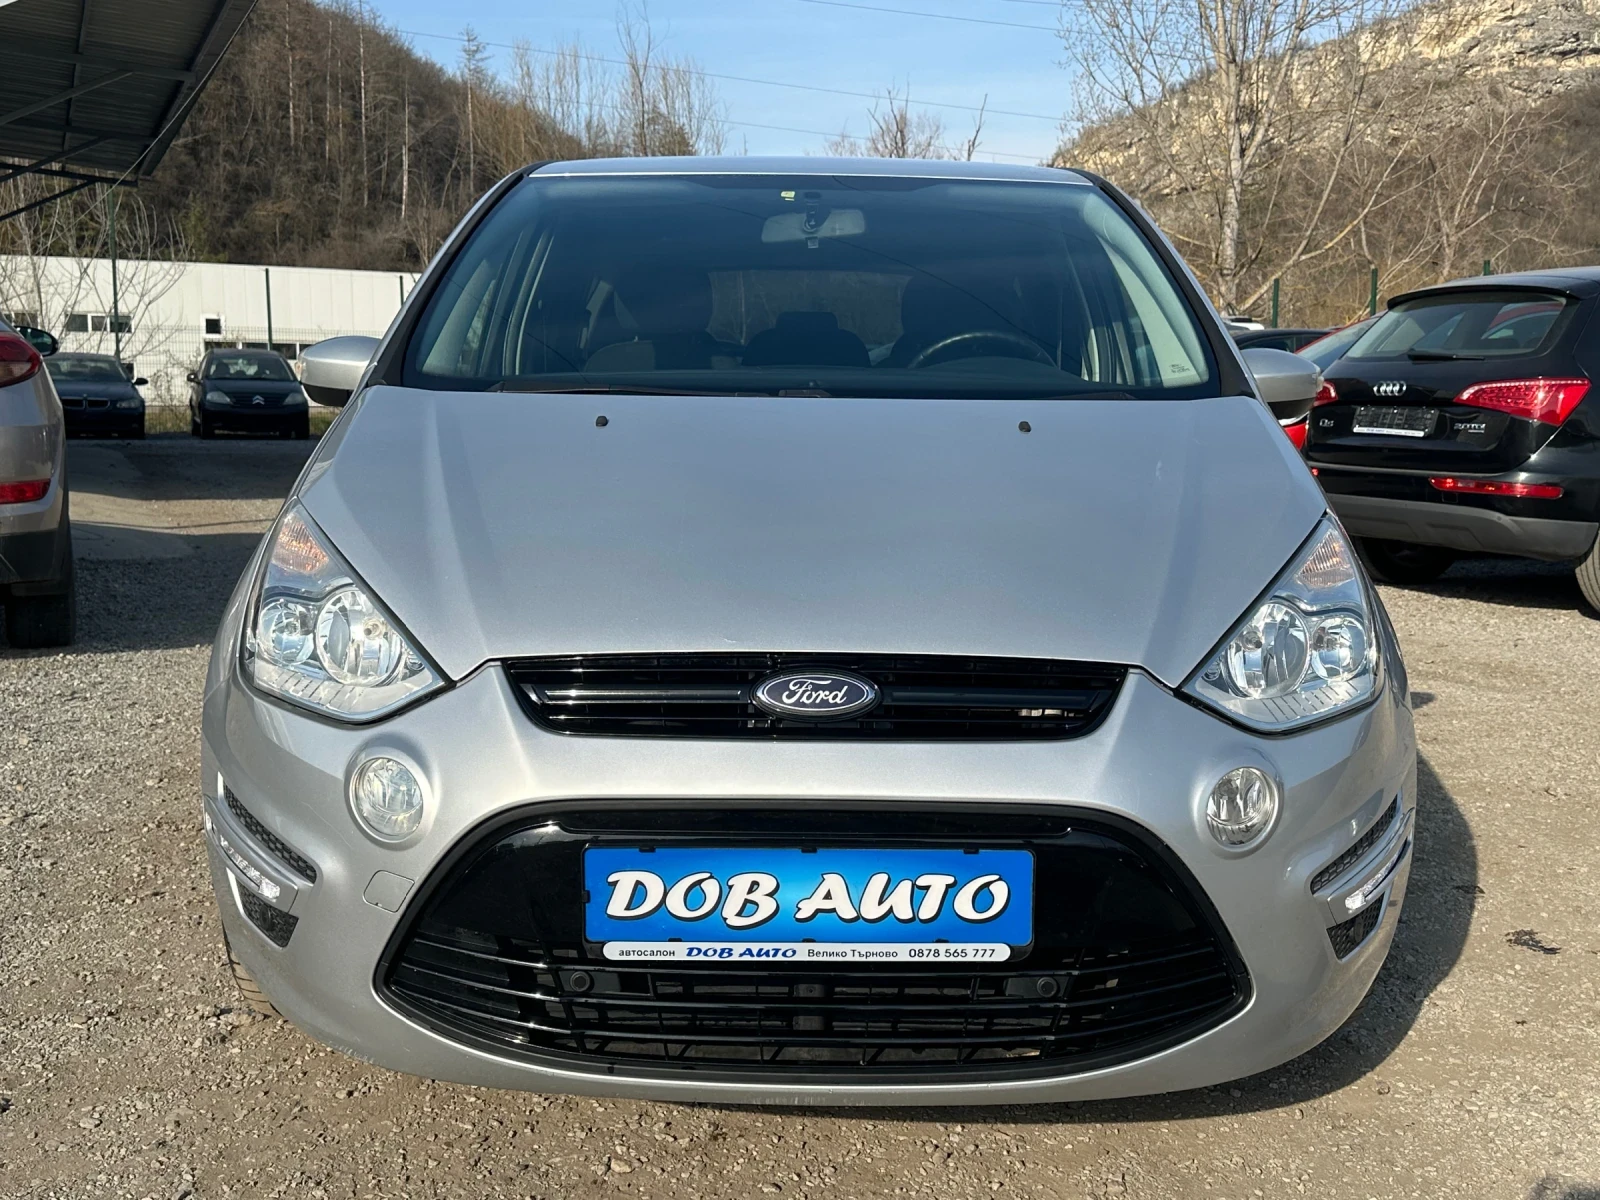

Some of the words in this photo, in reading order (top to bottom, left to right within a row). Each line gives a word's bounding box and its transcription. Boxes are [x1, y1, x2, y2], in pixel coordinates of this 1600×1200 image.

[782, 679, 848, 704] Ford
[606, 870, 780, 930] DOB
[794, 872, 1011, 923] AUTO
[618, 949, 675, 957] автосалон
[685, 947, 733, 958] DOB
[738, 947, 797, 958] AUTO
[807, 949, 847, 958] Велико
[850, 949, 898, 960] Търново
[908, 948, 941, 958] 0878
[944, 948, 968, 958] 565
[972, 948, 996, 958] 777
